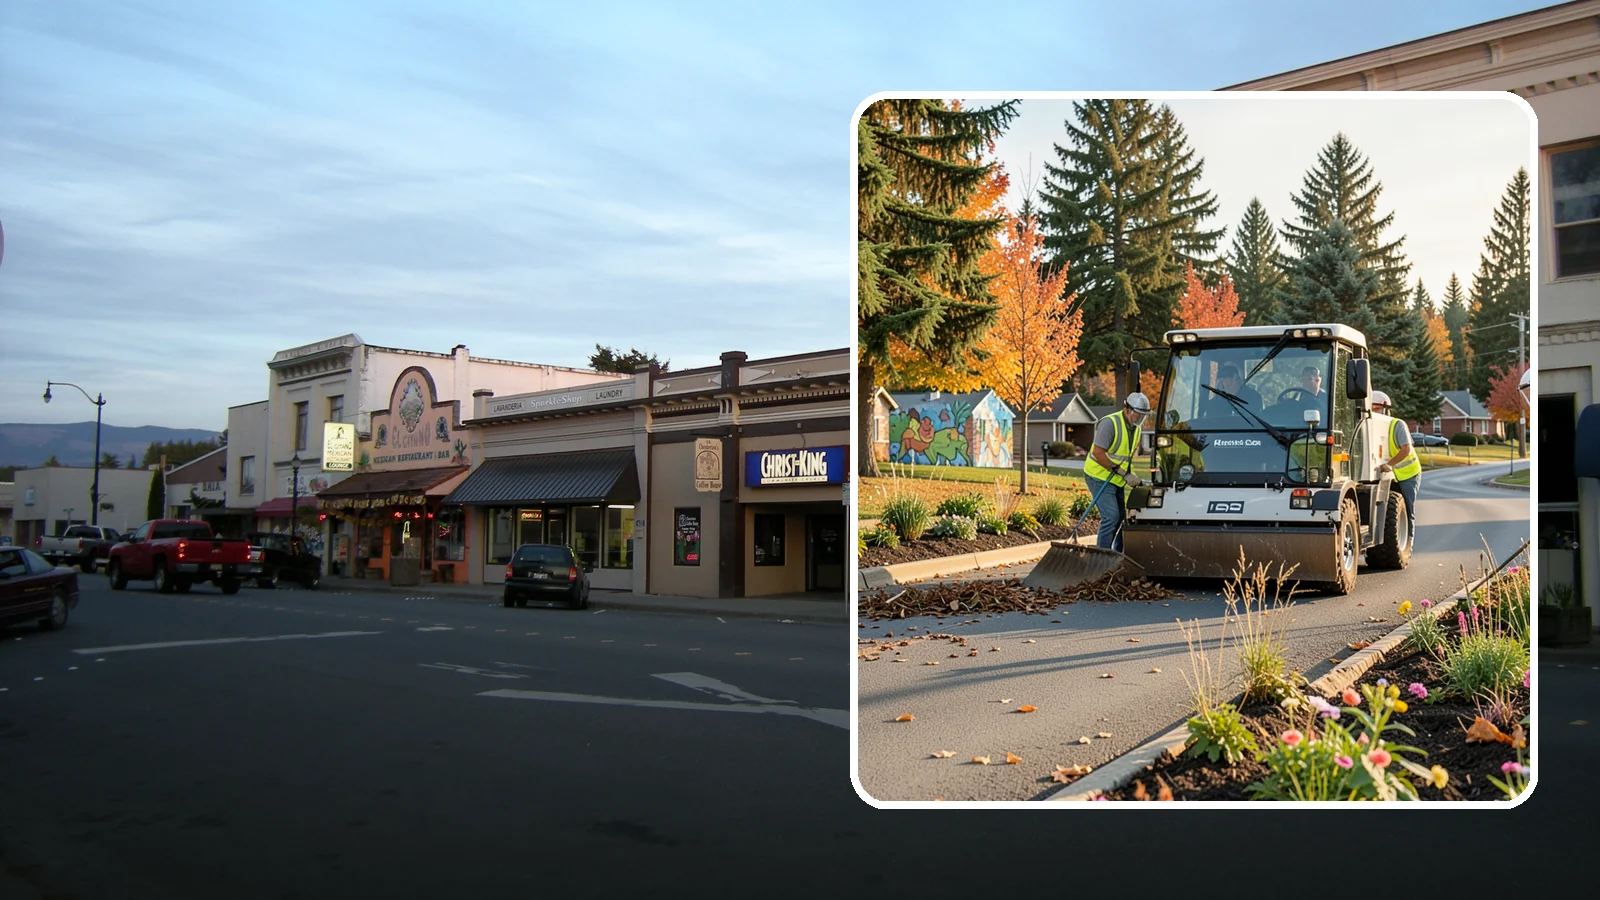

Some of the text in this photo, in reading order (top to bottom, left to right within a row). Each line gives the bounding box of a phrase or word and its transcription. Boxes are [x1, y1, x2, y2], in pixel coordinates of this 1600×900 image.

[530, 394, 583, 409] Sparkle Shop
[596, 389, 624, 400] LAUNDRY
[494, 402, 523, 413] LAVANDERIA
[374, 455, 397, 464] MEXICAN
[398, 452, 433, 462] RESTAURANT
[438, 450, 450, 459] BAR
[799, 450, 827, 476] KING
